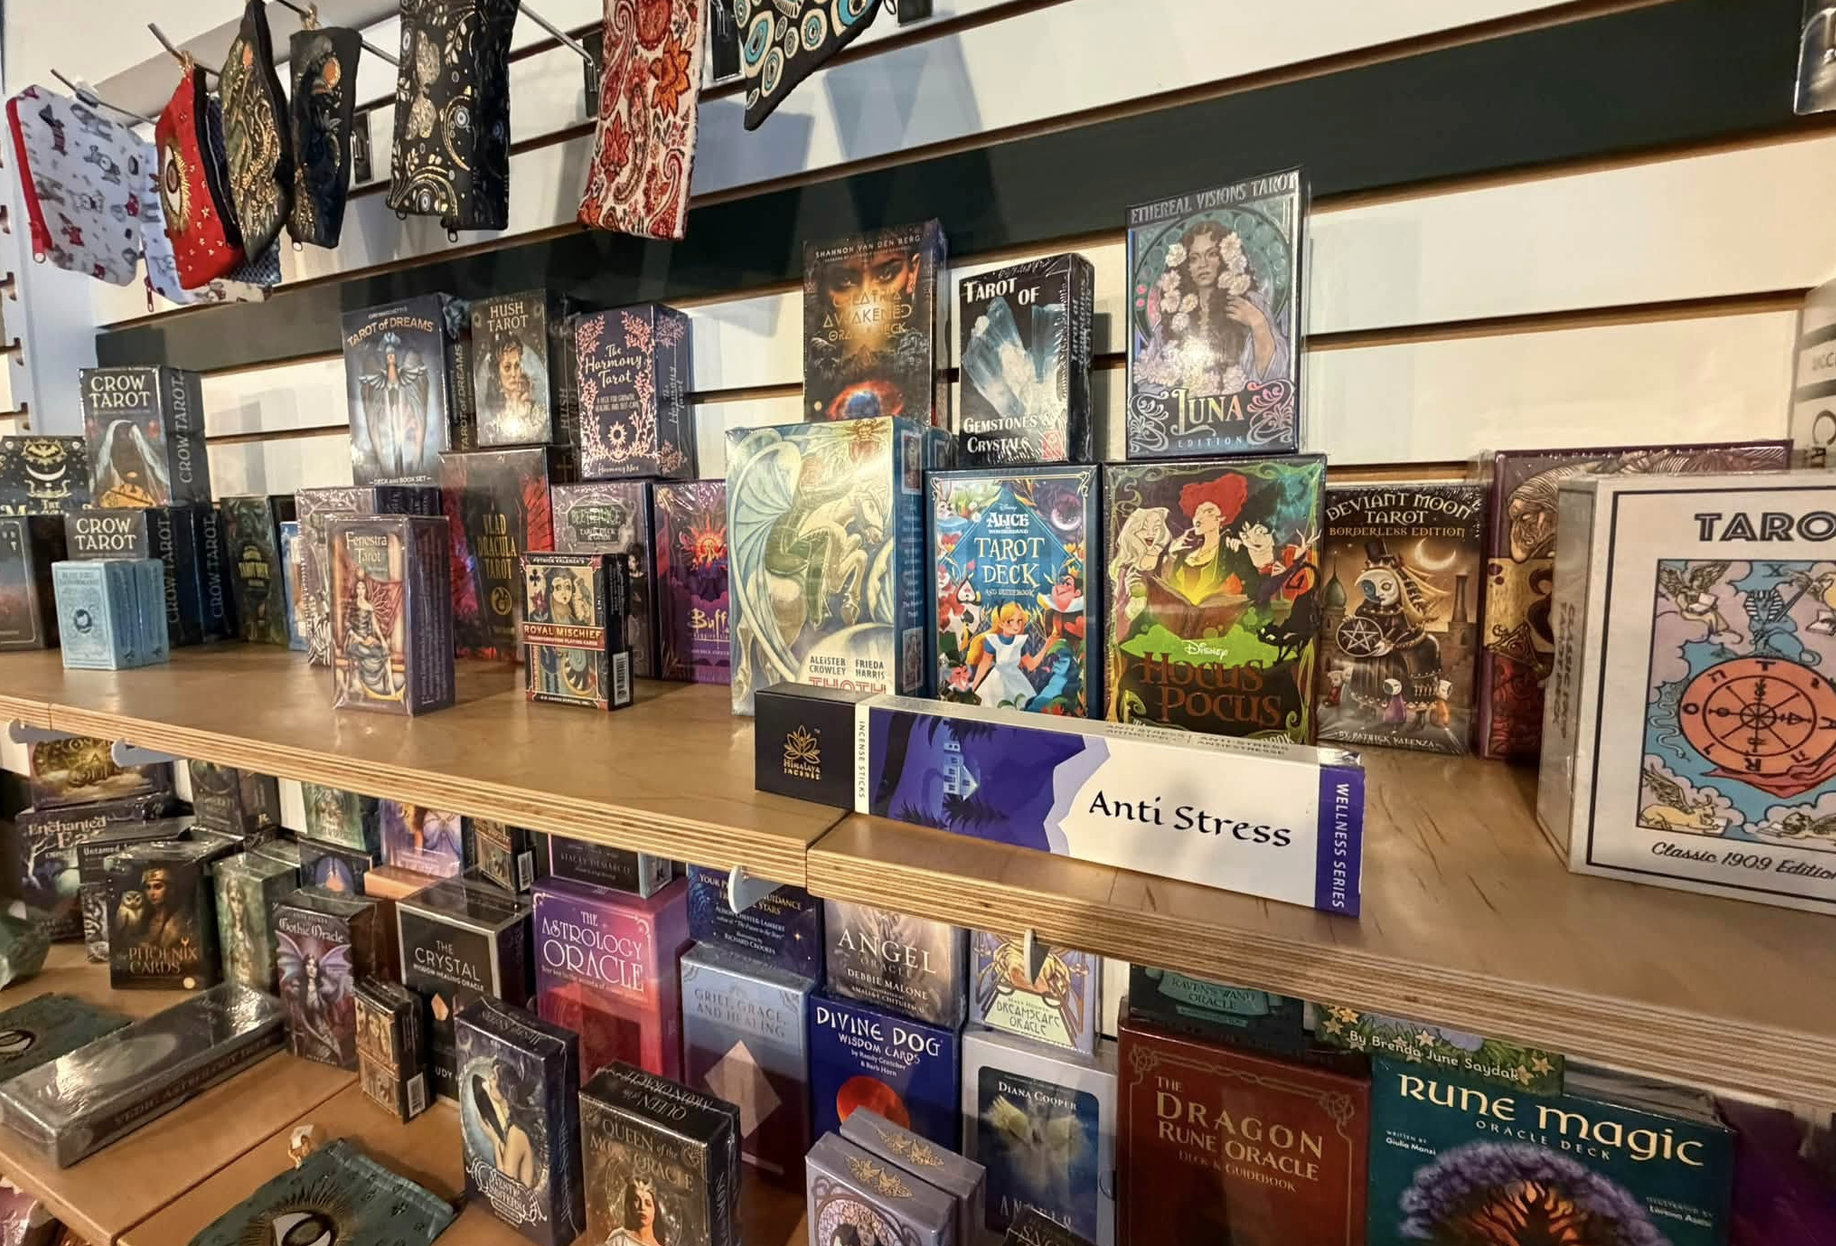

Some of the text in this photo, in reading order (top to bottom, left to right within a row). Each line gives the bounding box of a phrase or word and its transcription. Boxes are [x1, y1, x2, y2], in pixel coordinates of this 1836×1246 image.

[1130, 171, 1298, 224] ETHEREAL VISIONS TAROT
[815, 246, 854, 259] SHANNON
[857, 242, 875, 252] VAN
[877, 240, 894, 249] DEN
[898, 234, 921, 246] BERG
[963, 277, 1041, 306] TAROT OF
[489, 301, 525, 319] HUSH
[346, 316, 435, 348] TAROT of DREAMS
[487, 314, 529, 333] TAROT
[605, 343, 622, 358] The
[585, 354, 643, 375] Harmony
[89, 375, 146, 392] CROW
[598, 369, 633, 389] Tarot
[88, 391, 152, 409] TAROT
[1170, 387, 1244, 437] LUNA
[171, 374, 194, 484] CROW TAROT
[962, 415, 1039, 434] GEMSTONES
[966, 435, 1030, 456] CRYSTALS
[1177, 435, 1243, 449] EDITION
[415, 474, 427, 483] SET
[1326, 492, 1472, 522] DEVIANT MOON
[1363, 510, 1430, 526] TAROT
[75, 517, 132, 535] CROW
[482, 513, 508, 535] VLAD
[985, 512, 1030, 528] ALICE
[73, 533, 138, 552] TAROT
[345, 531, 388, 550] Fenestra
[1328, 526, 1466, 539] BORDERLESS EDITION
[355, 548, 382, 564] Tarot
[476, 535, 518, 559] DRACULA
[973, 537, 1046, 563] TAROT
[158, 516, 180, 625] CROW TAROT
[203, 515, 225, 619] CROW TAROT
[483, 557, 513, 580] TAROT
[982, 563, 1042, 589] DECK
[984, 588, 1037, 598] AND GUIDEBOOK
[524, 624, 554, 636] ROYAL
[556, 626, 602, 639] MISCHIEF
[687, 607, 729, 650] Buff
[1180, 638, 1230, 658] Disney
[808, 665, 886, 680] CROWLEY HARRIS
[809, 655, 885, 670] ALEISTER FRIEDA
[1140, 650, 1265, 693] HOCUS
[1151, 684, 1285, 726] POCUS
[1337, 729, 1436, 748] BY PATRICK VALENZA
[783, 758, 821, 774] Himalaya
[858, 720, 867, 799] INCENSE STICKS
[783, 768, 821, 780] INCENSE
[27, 814, 109, 836] Enchanted
[1088, 789, 1293, 848] Anti Stress
[1331, 782, 1351, 911] WELLNESS SERIES
[1649, 840, 1717, 864] Classic
[1720, 851, 1773, 872] 1909
[699, 872, 721, 888] YOUR
[580, 910, 599, 928] THE
[758, 900, 782, 917] STARS
[278, 917, 345, 944] Gothic Oracle
[541, 916, 643, 961] ASTROLOGY
[128, 945, 198, 963] PHOENIX
[436, 939, 454, 956] THE
[837, 928, 938, 975] ANGEL
[129, 960, 182, 975] CARDS
[413, 947, 482, 982] CRYSTAL
[543, 939, 644, 993] ORACLE
[859, 956, 912, 981] ORACLE
[461, 979, 485, 993] ORACLE
[847, 967, 882, 986] DEBBIE
[884, 979, 929, 1001] MALONE
[1187, 992, 1238, 1011] ORACLE
[695, 1002, 786, 1039] AND HEALING
[736, 1001, 788, 1028] GRACE,
[996, 999, 1061, 1028] DREAMSCAPE
[816, 1006, 941, 1057] DIVINE DOG
[1009, 1015, 1048, 1037] ORACLE
[838, 1032, 921, 1067] WISDOM CARDS
[851, 1048, 859, 1057] by
[859, 1050, 880, 1064] Randy
[1348, 1029, 1520, 1082] By Brenda June Saydak
[997, 1080, 1078, 1111] DIANA COOPER
[1155, 1075, 1184, 1094] THE
[1155, 1090, 1324, 1160] DRAGON
[1386, 1130, 1416, 1142] WRITTEN
[602, 1119, 655, 1154] QUEEN
[1385, 1137, 1410, 1152] Giulia
[1475, 1119, 1612, 1162] ORACLE DECK
[1158, 1120, 1321, 1183] RUNE ORACLE
[634, 1152, 694, 1193] ORACLE
[1225, 1163, 1298, 1194] GUIDEBOOK
